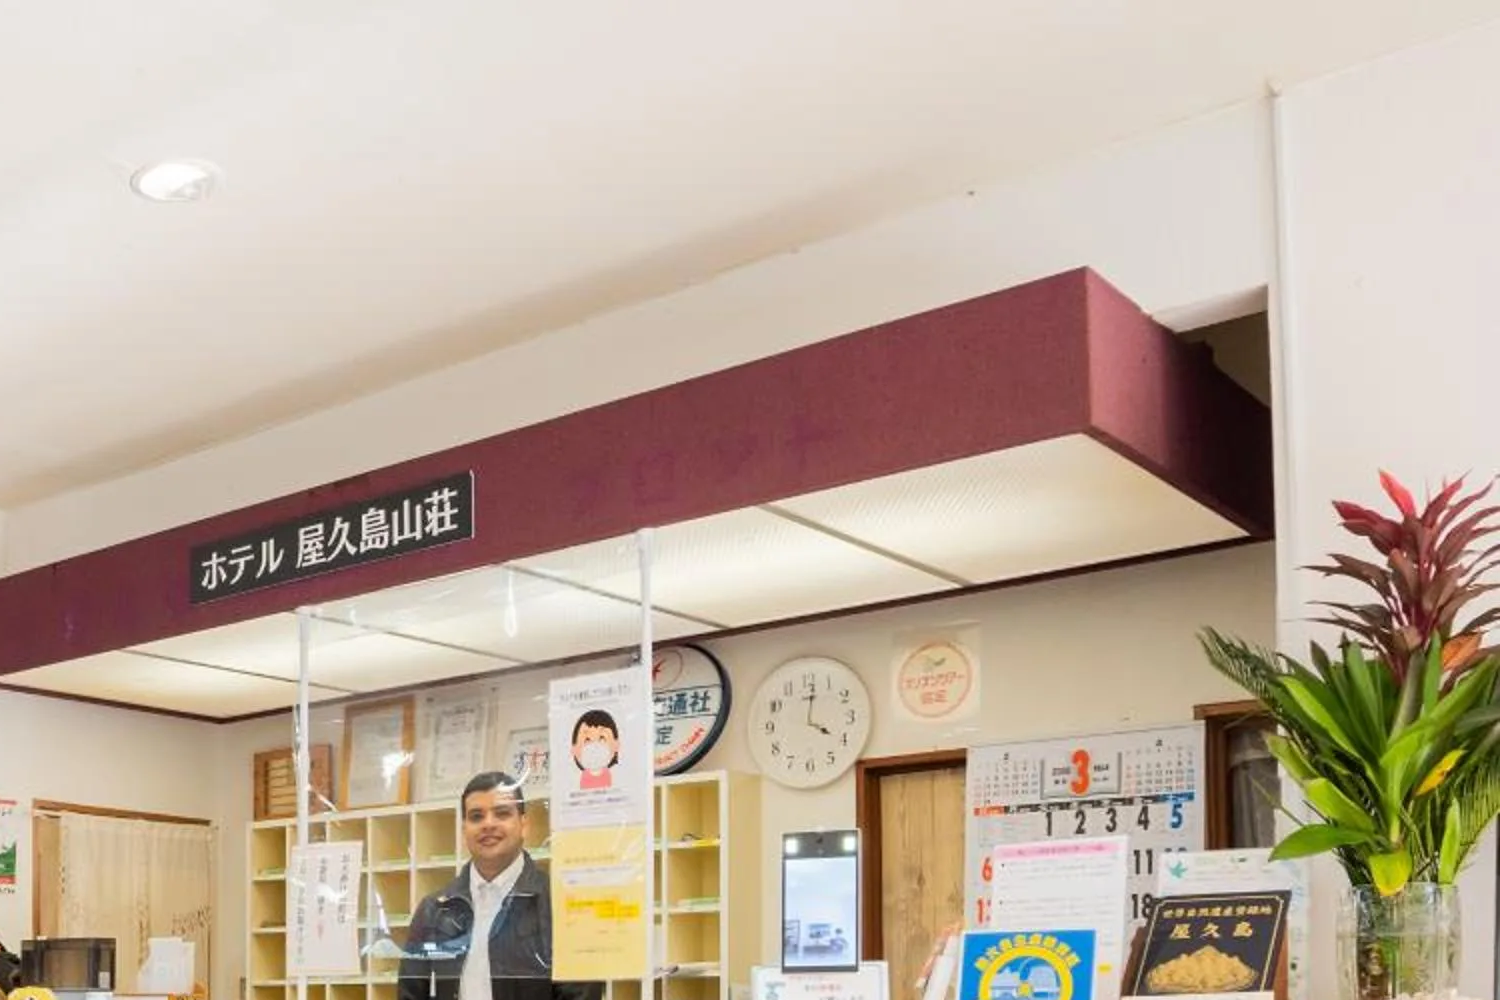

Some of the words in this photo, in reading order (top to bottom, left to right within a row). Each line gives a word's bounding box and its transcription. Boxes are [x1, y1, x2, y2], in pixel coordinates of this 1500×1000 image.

[201, 538, 285, 590] ホテル
[296, 487, 459, 569] 屋久島山荘
[1070, 749, 1091, 795] 3
[1045, 811, 1053, 837] 1
[1075, 810, 1087, 835] 2
[1106, 808, 1117, 833] 3
[1137, 806, 1149, 831] 4
[1170, 804, 1183, 829] 5
[981, 857, 993, 882] 6
[1133, 849, 1153, 875] 11
[1169, 921, 1254, 939] 屋久島
